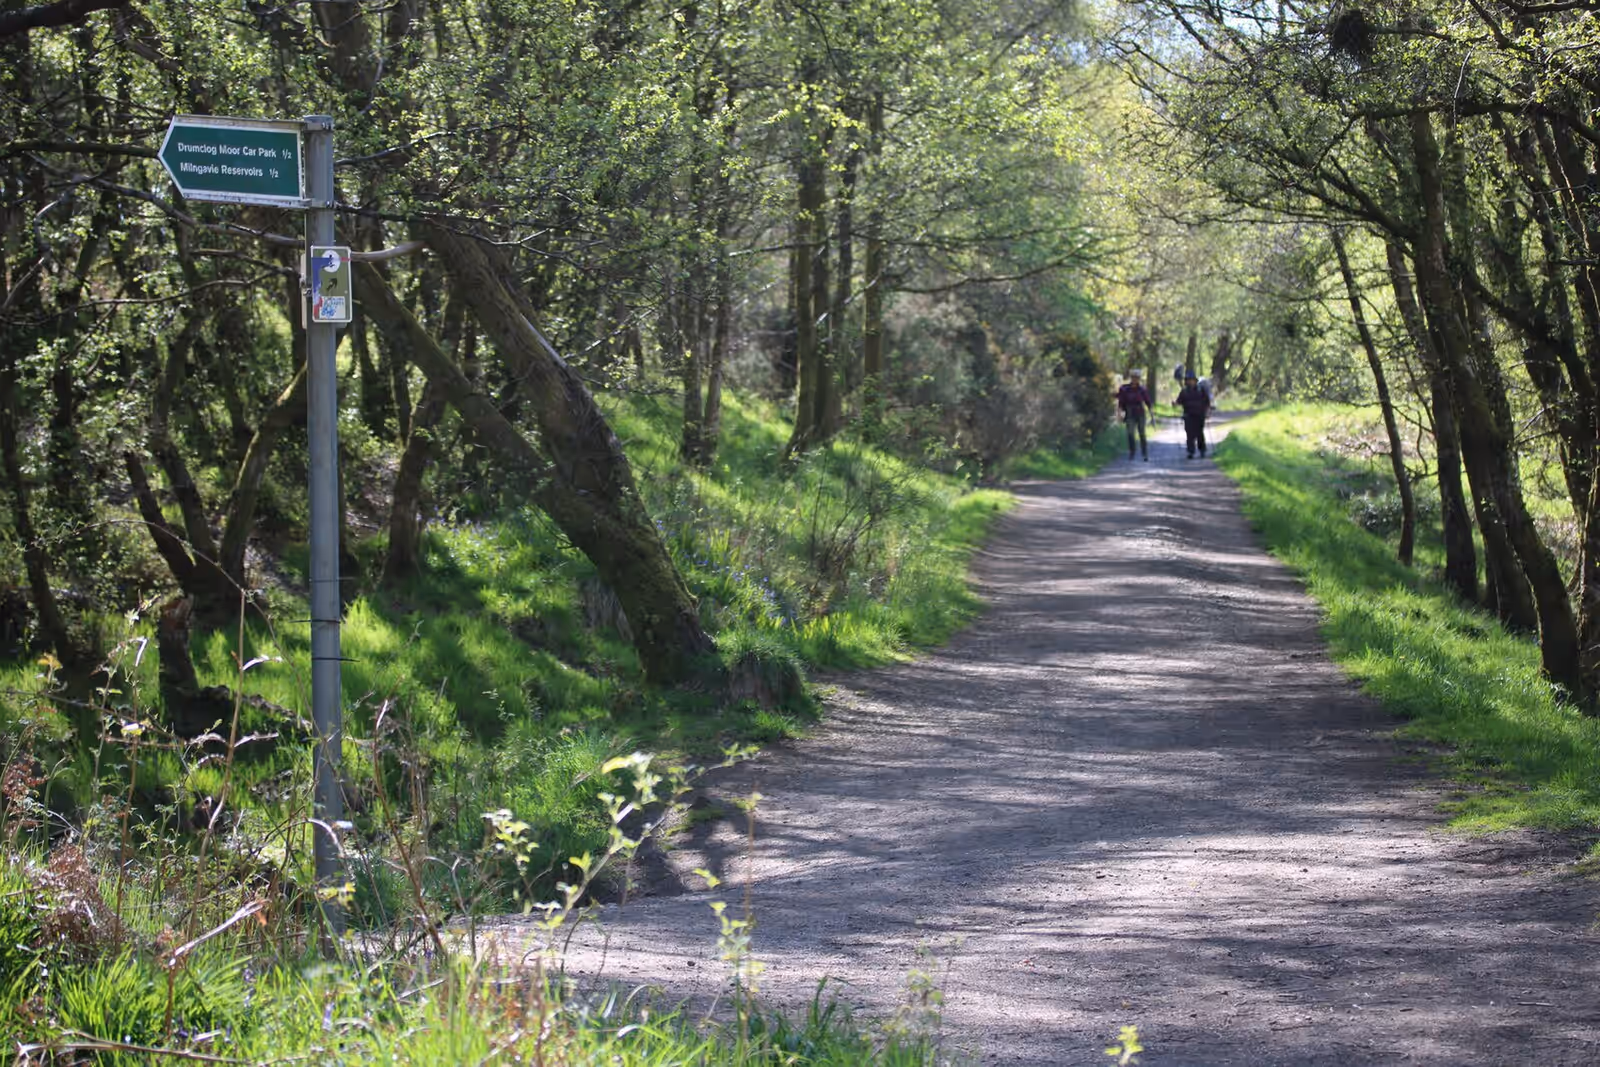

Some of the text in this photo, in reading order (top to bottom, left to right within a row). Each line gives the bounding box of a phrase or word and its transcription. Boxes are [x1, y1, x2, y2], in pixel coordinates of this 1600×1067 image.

[177, 142, 217, 156] Drumclog
[219, 144, 240, 156] Moor
[242, 146, 256, 157] Car
[258, 147, 277, 158] Park
[180, 162, 219, 175] Milngavie
[221, 164, 264, 177] Reservoirs
